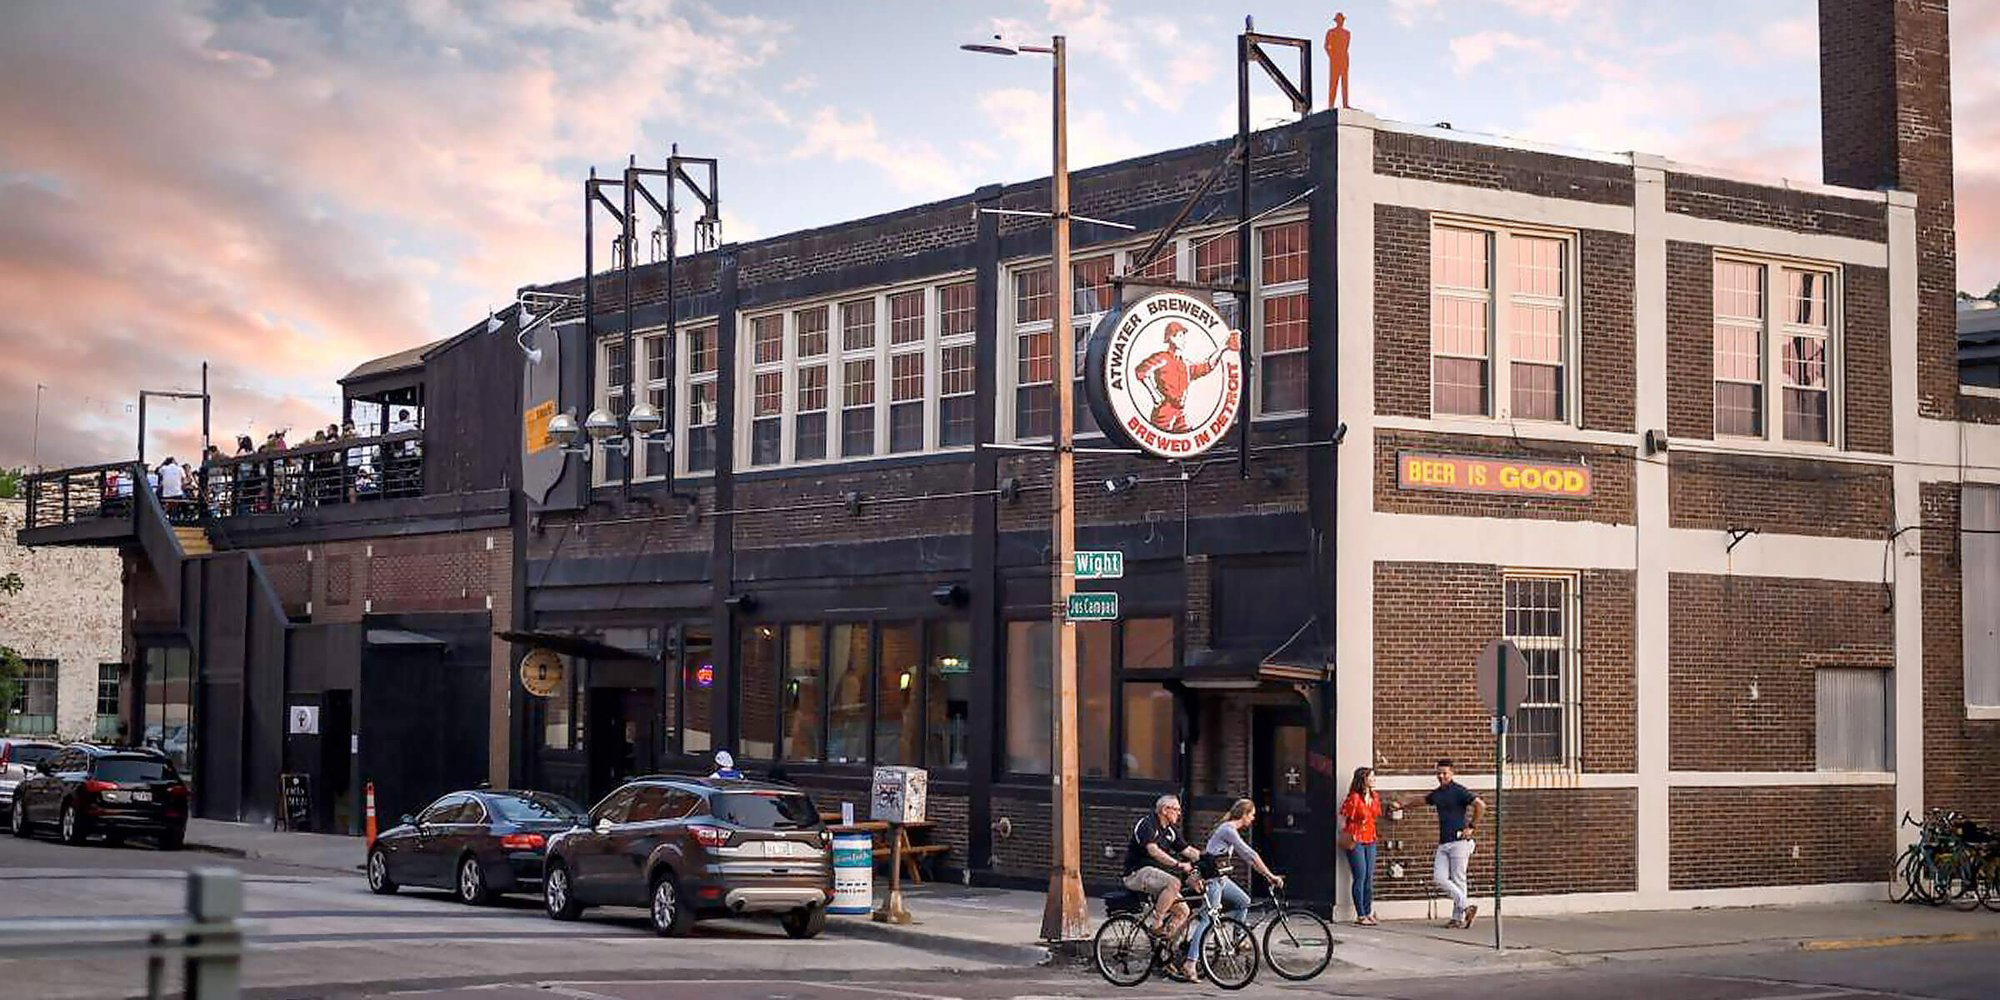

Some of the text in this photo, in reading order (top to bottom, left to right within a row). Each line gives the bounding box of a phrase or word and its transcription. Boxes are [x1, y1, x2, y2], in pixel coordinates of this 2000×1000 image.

[1111, 298, 1219, 390] ATWATER BREWERY
[1127, 362, 1239, 452] BREWED IN DETROIT
[1409, 460, 1585, 493] BEER IS GOOD
[1077, 554, 1119, 577] Wight
